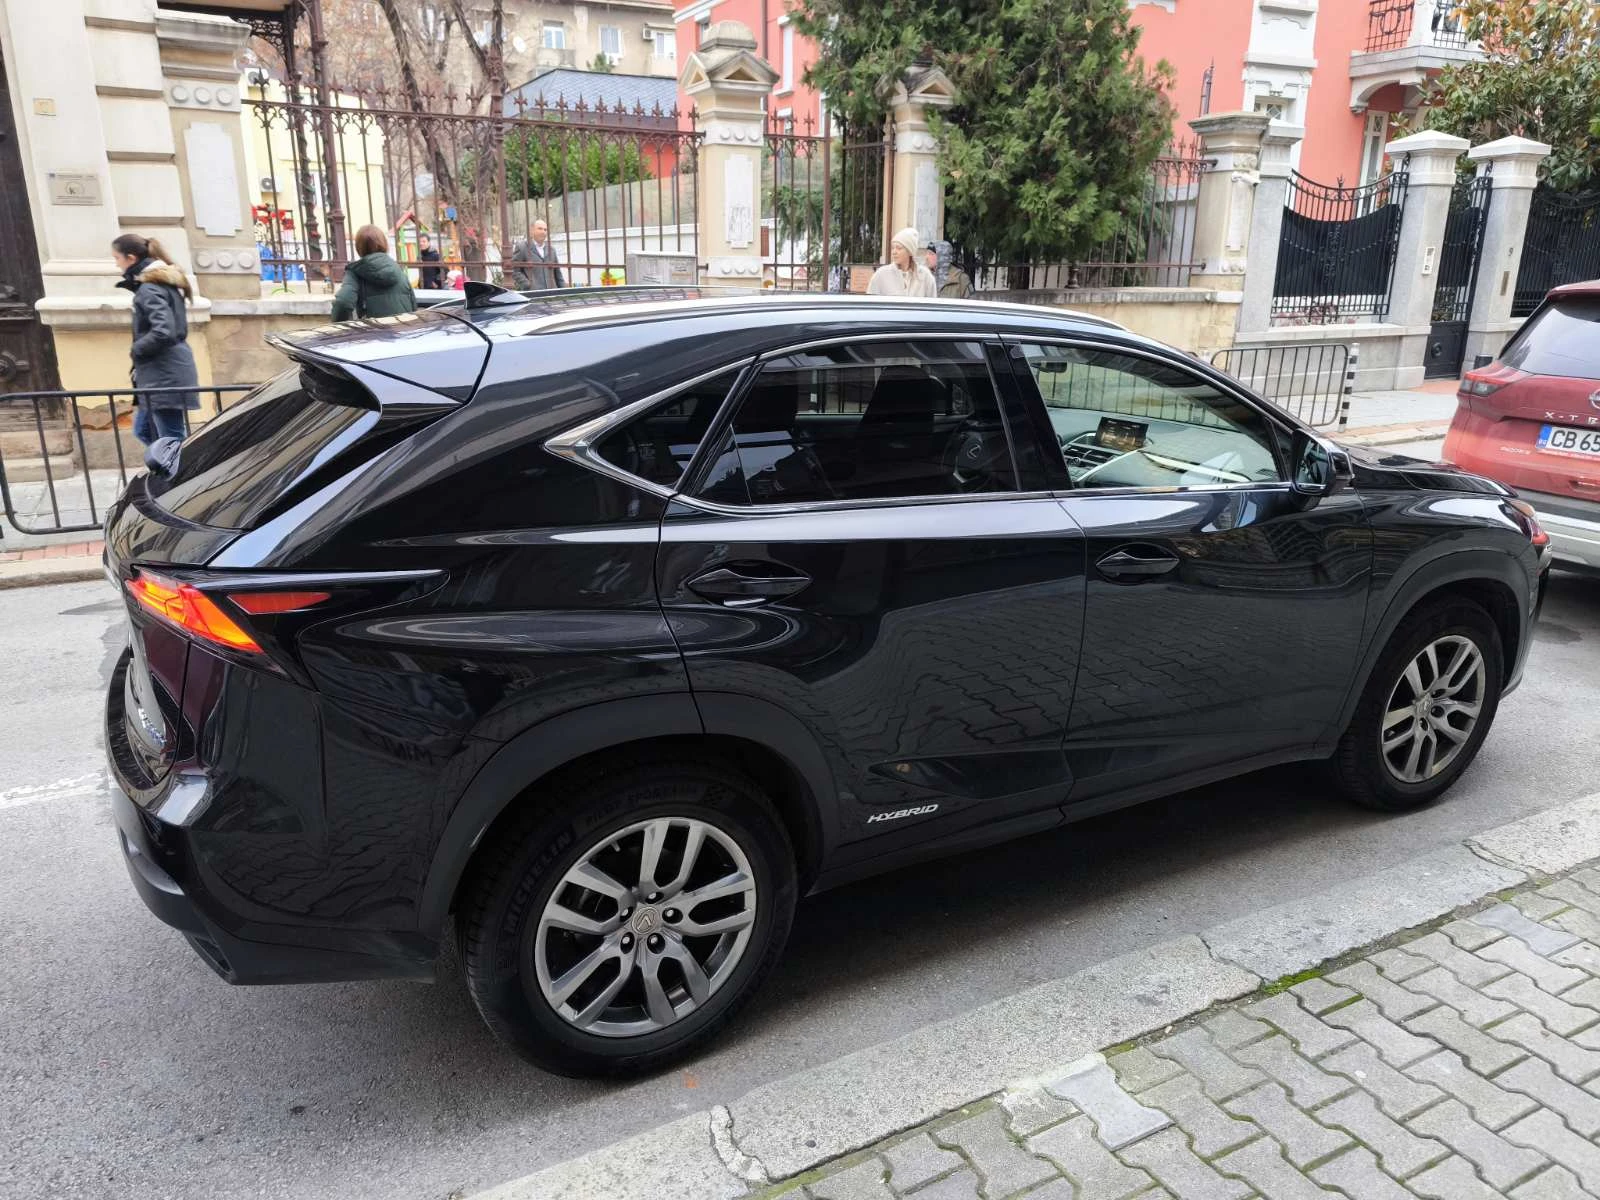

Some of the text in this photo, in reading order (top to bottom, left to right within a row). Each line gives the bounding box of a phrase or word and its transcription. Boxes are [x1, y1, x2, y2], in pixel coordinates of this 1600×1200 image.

[1551, 430, 1600, 452] CB 65
[866, 803, 939, 824] HYBRID
[503, 831, 572, 933] MICHELIN
